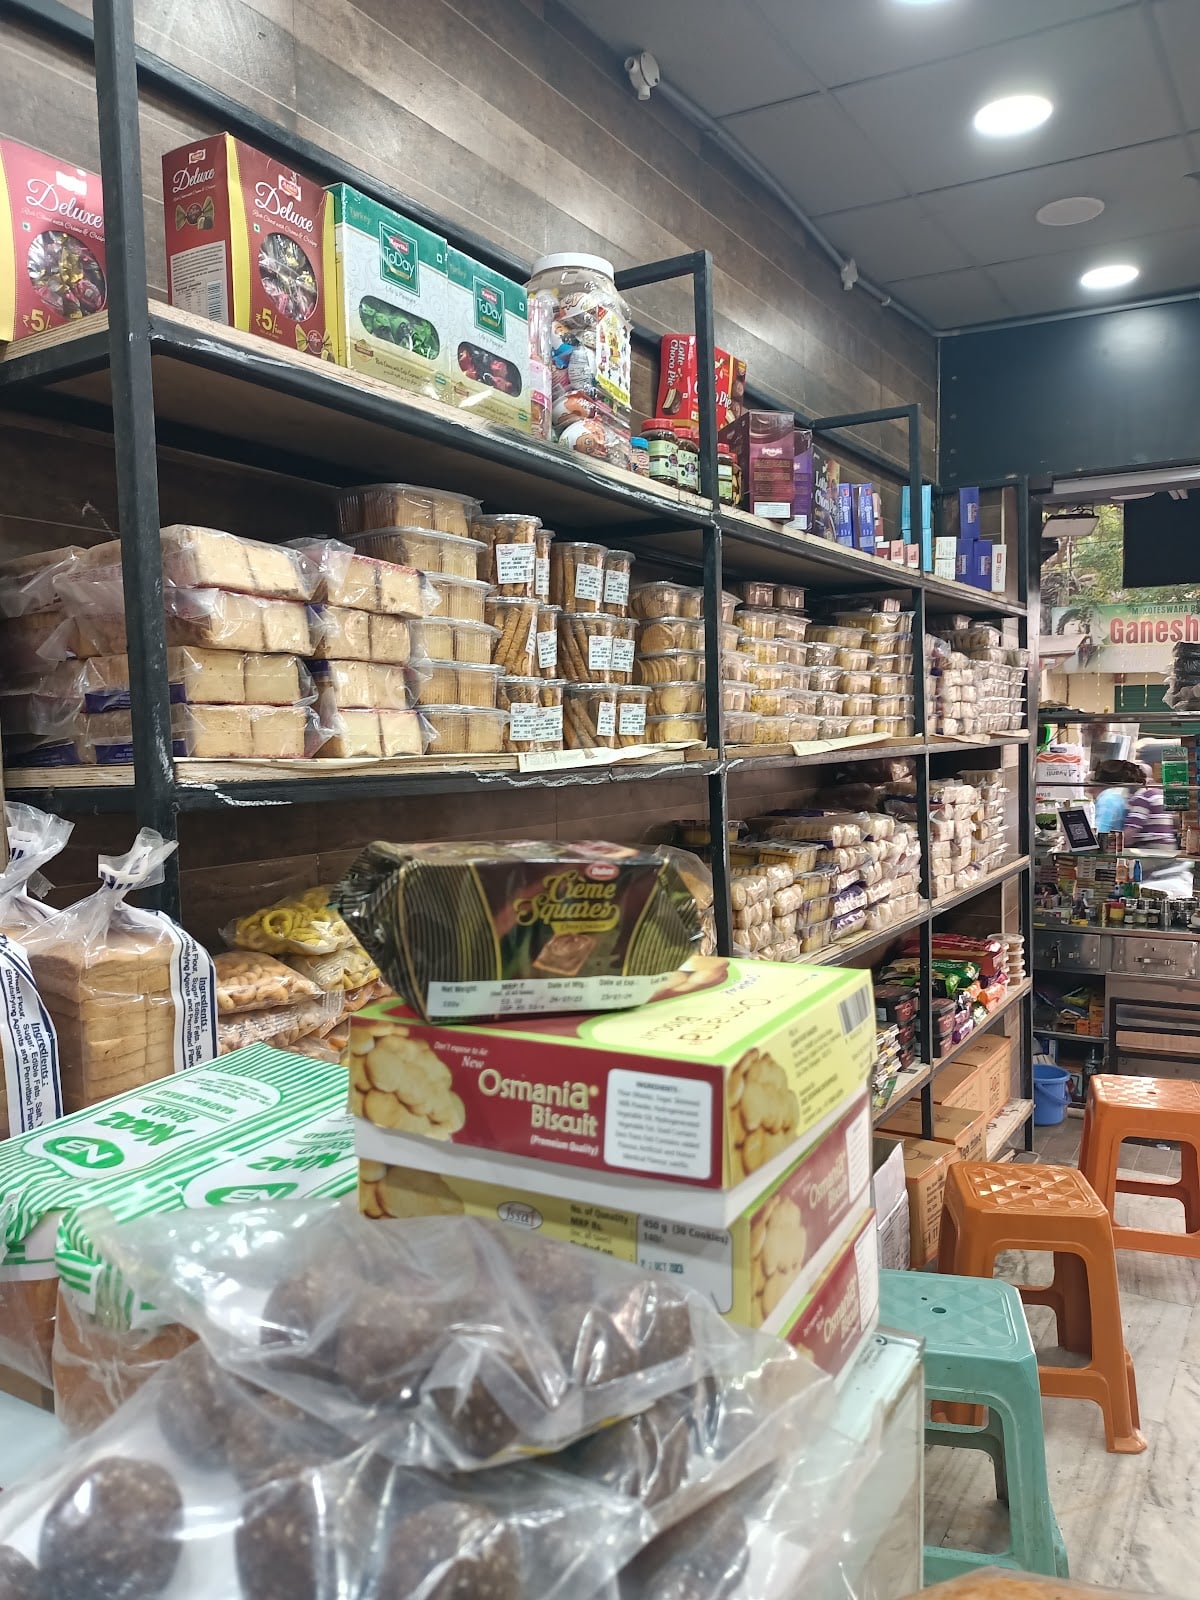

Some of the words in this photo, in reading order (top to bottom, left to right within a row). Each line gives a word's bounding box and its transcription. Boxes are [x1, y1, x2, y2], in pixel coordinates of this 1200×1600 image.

[172, 166, 216, 193] Deluxe
[26, 178, 104, 229] Deluxe
[254, 181, 314, 233] Deluxe
[384, 246, 416, 279] ToDay
[477, 297, 503, 326] ToDay
[668, 339, 678, 370] Choco
[677, 340, 688, 366] Lotte
[667, 370, 677, 387] Pie
[720, 390, 733, 409] Pie
[1110, 614, 1199, 644] Ganesh
[513, 894, 620, 927] Squares
[191, 953, 200, 974] Flour,
[182, 971, 191, 997] Agents
[190, 977, 200, 1001] Sugar,
[193, 1001, 201, 1024] Edible
[199, 976, 209, 1026] Ingredients
[12, 1018, 25, 1047] Agents
[18, 995, 26, 1020] Flour,
[23, 1023, 33, 1050] Sugar,
[31, 1051, 39, 1078] Edible
[20, 1048, 29, 1066] and
[31, 1022, 49, 1081] Ingredients
[461, 1055, 485, 1069] New
[23, 1066, 34, 1107] Permitted
[478, 1068, 590, 1110] Osmania
[95, 1110, 197, 1146] Naaz
[141, 1104, 198, 1123] BREAD
[530, 1104, 598, 1137] Biscuit
[247, 1152, 344, 1172] Naaz
[570, 1216, 590, 1227] MRP
[643, 1218, 660, 1231] 450
[661, 1223, 668, 1234] g
[672, 1222, 687, 1236] (30
[688, 1226, 729, 1246] Cookies)
